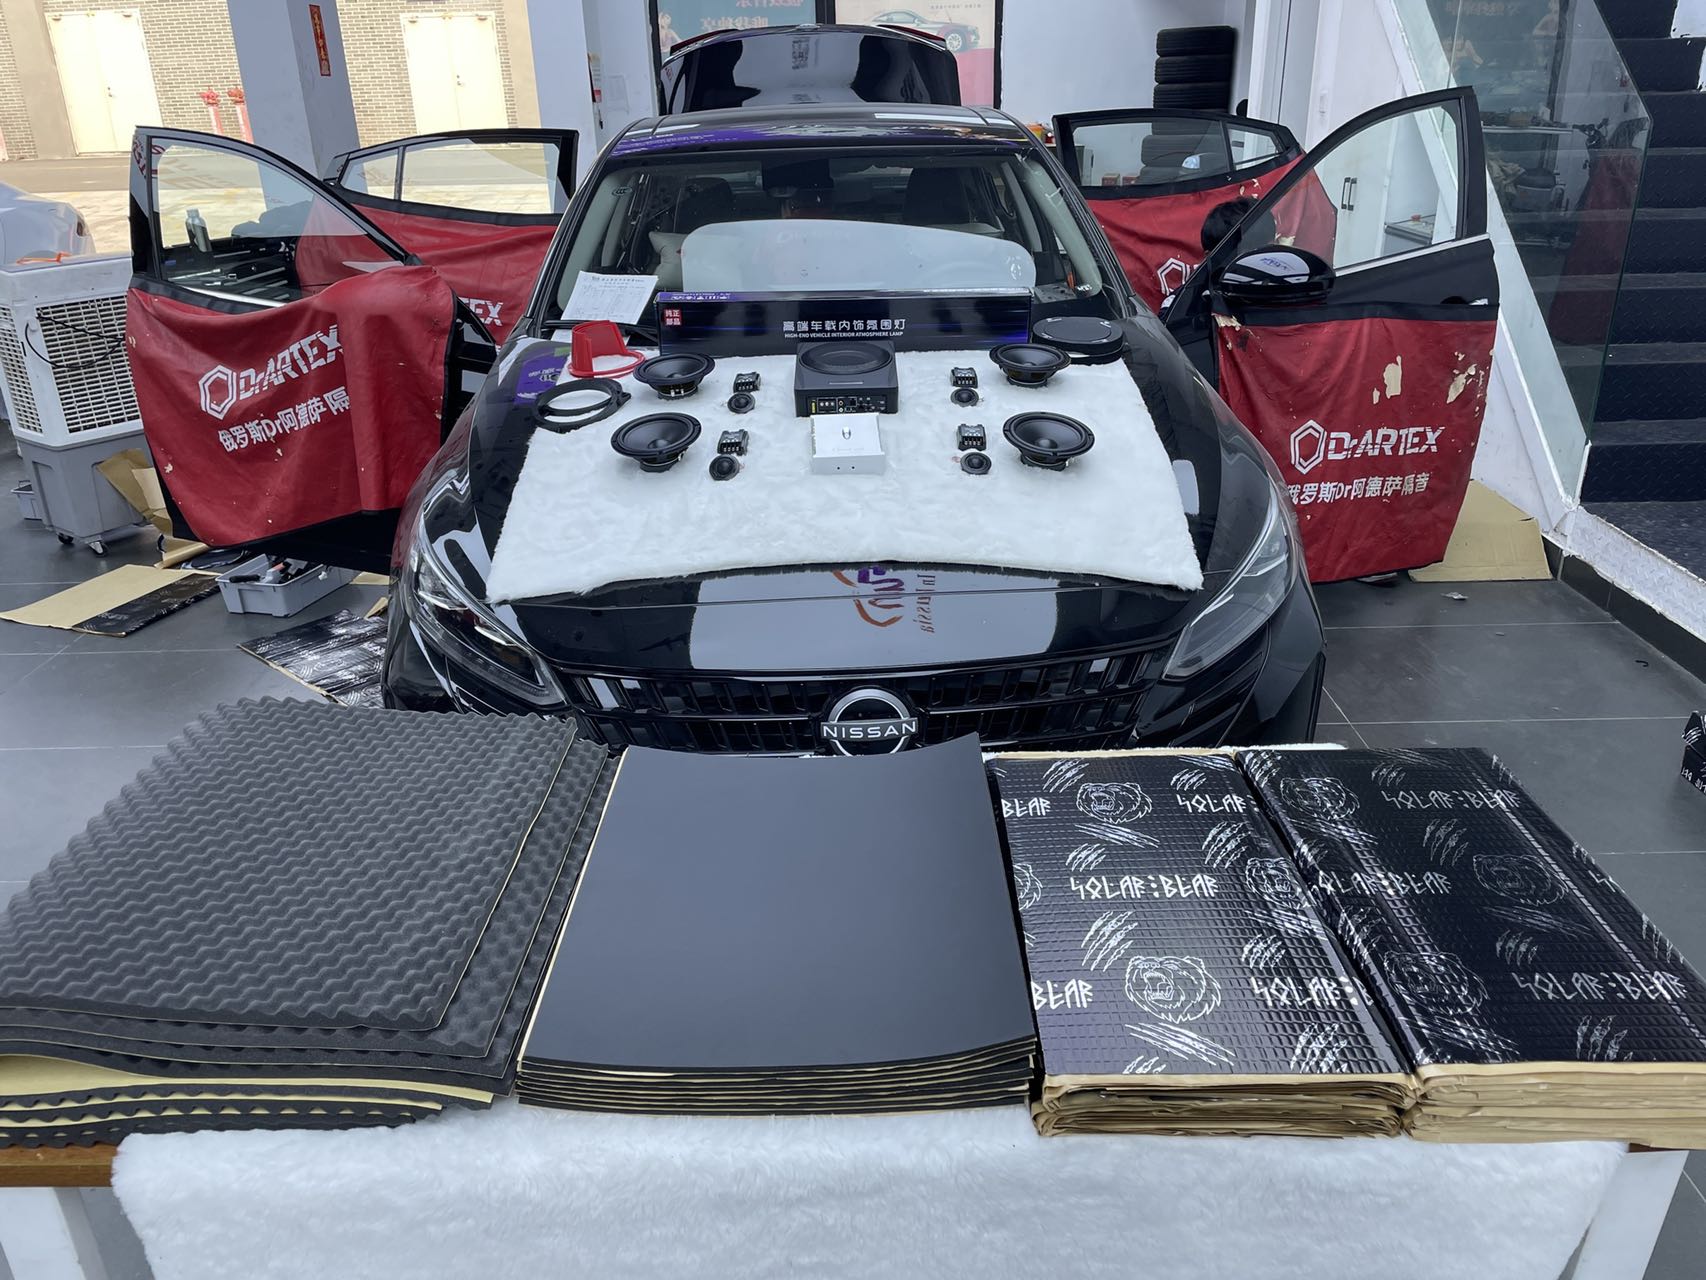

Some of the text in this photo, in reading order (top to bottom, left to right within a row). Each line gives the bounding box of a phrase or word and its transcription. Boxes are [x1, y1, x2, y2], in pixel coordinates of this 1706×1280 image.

[782, 319, 906, 331] 高端车载内饰氛围灯
[822, 721, 917, 739] NISSAN
